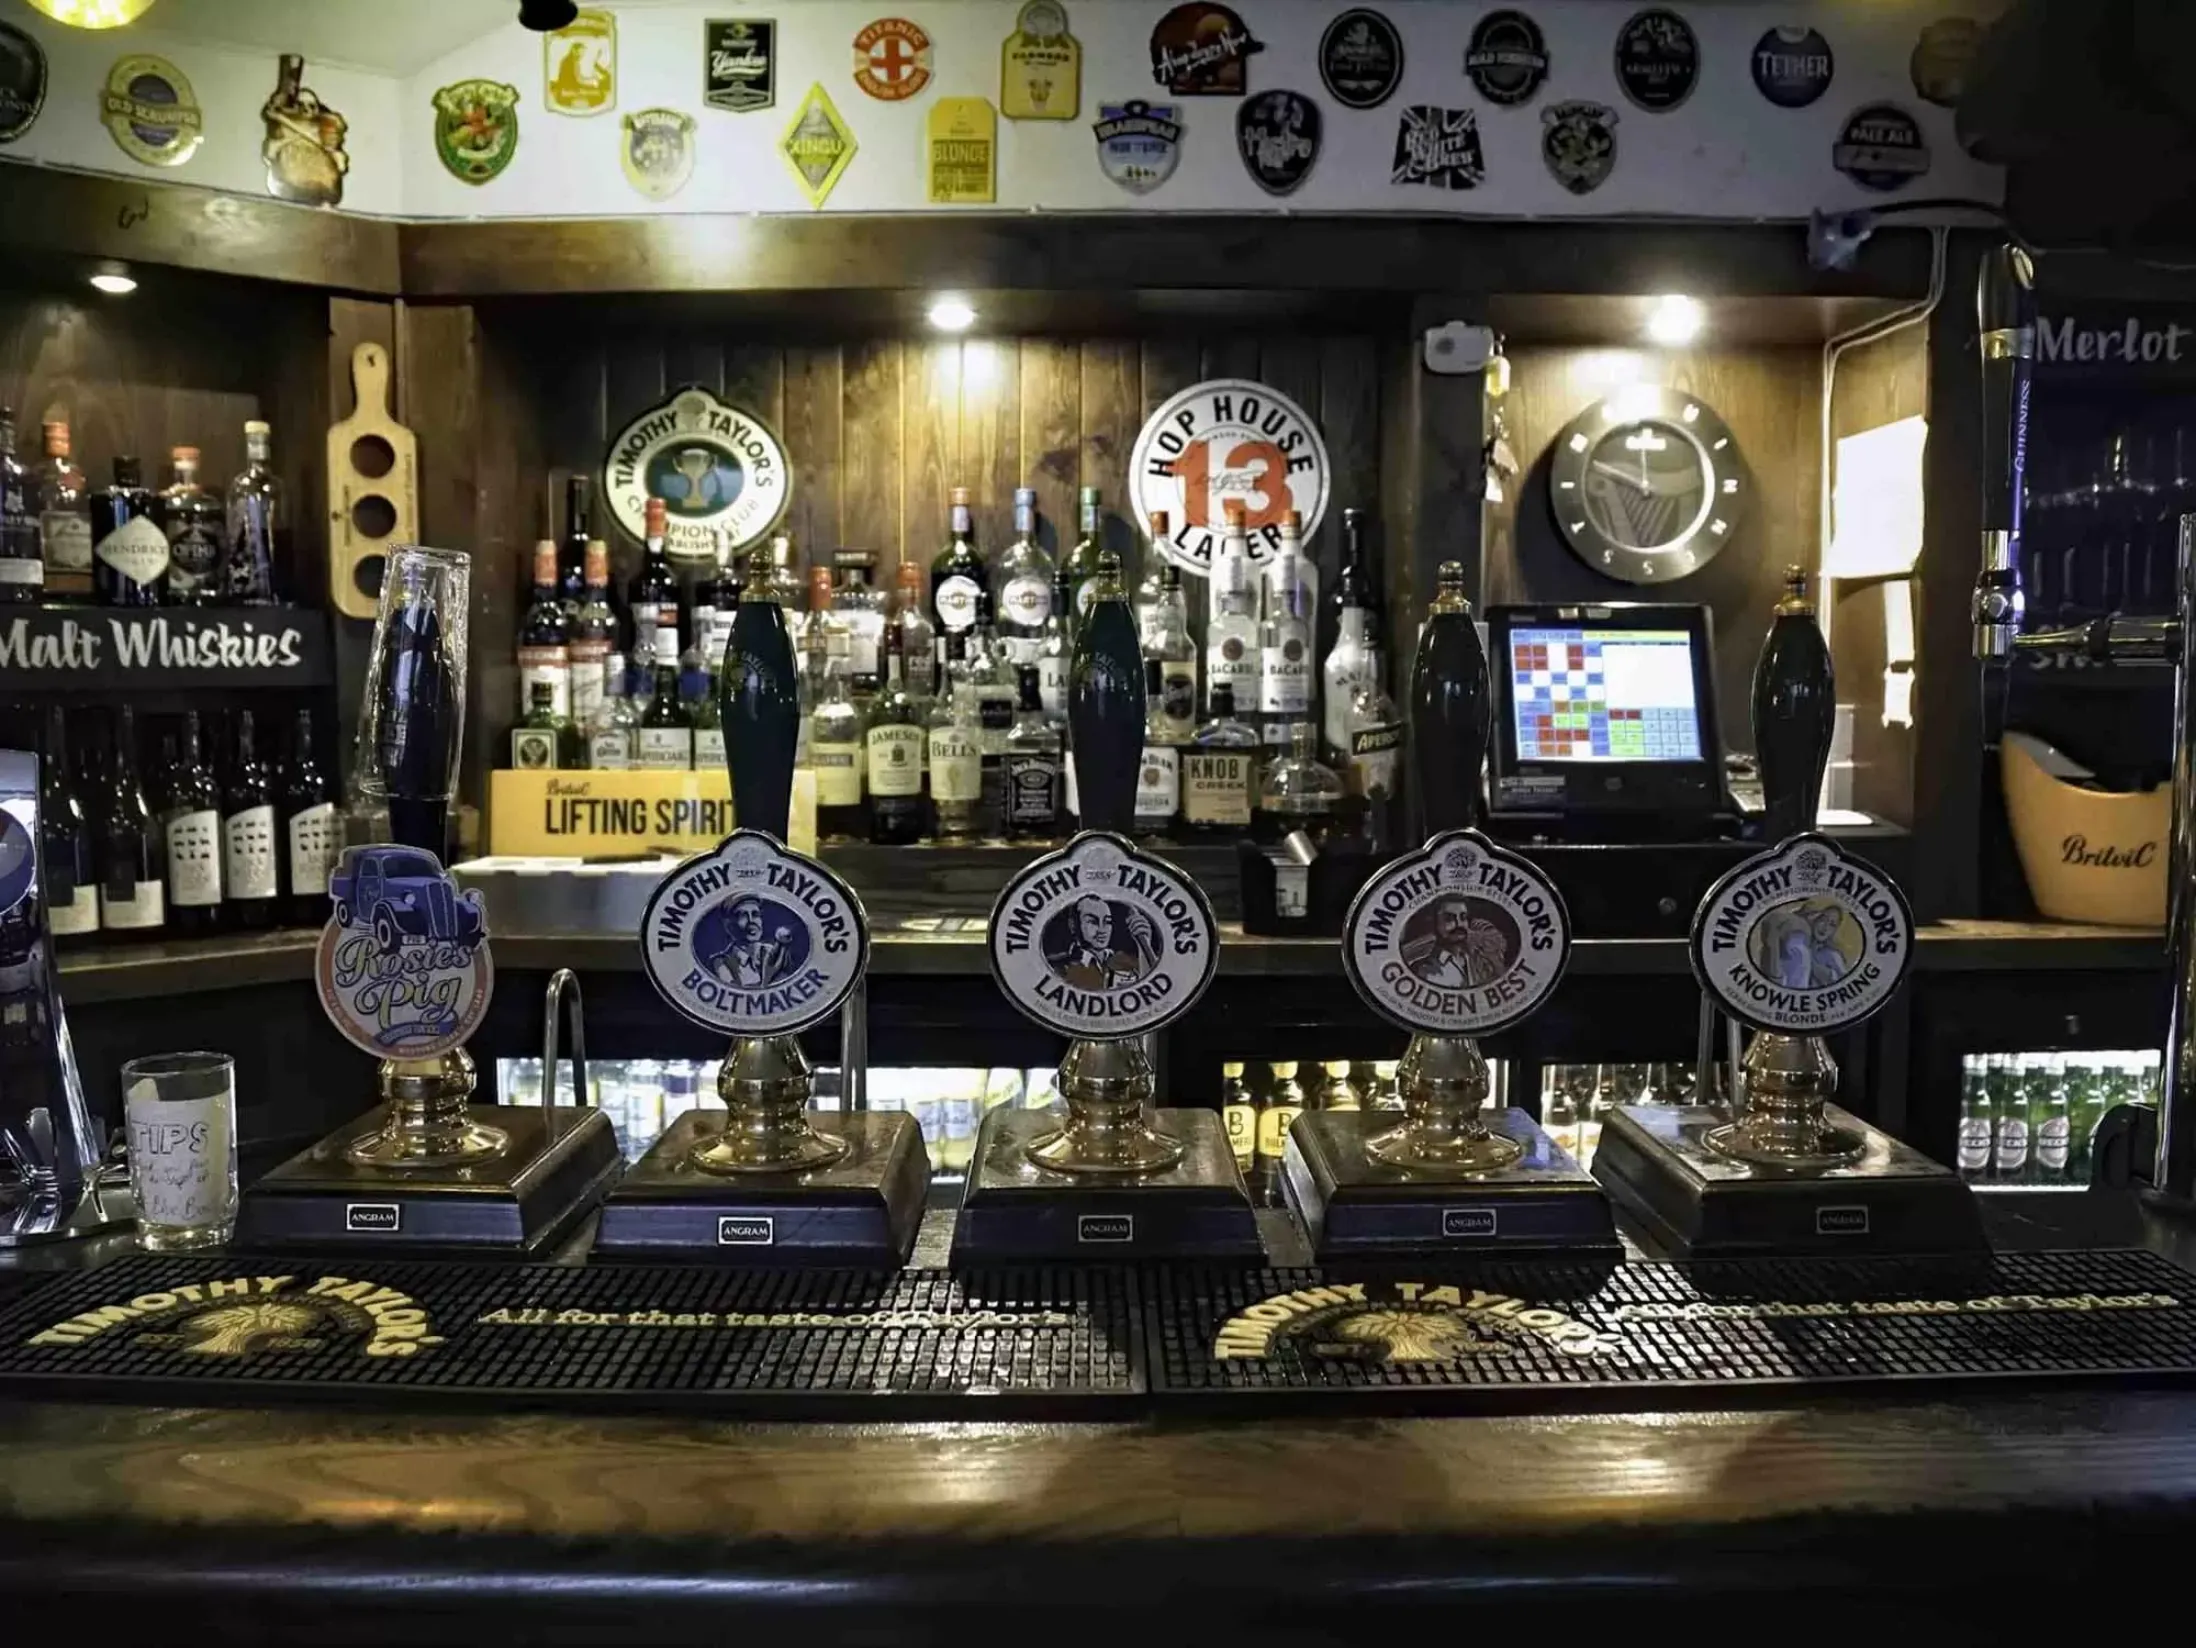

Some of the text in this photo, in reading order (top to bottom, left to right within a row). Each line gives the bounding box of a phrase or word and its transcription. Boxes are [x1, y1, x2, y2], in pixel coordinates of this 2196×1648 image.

[1758, 52, 1829, 80] TETHER
[2035, 316, 2193, 361] Merlot
[615, 411, 773, 489] TIMOTHY TAYLOR'S
[1148, 394, 1314, 477] HOP HOUSE
[2013, 380, 2030, 472] GUINNESS
[1173, 440, 1293, 527] 13
[0, 616, 302, 669] Malt Whiskies
[1191, 758, 1240, 778] KNOB
[545, 799, 646, 835] LIFTING
[658, 863, 848, 954] TIMOTHY TAYLOR'S
[1007, 865, 1201, 955] TIMOTHY TAYLOR'S
[1365, 863, 1557, 955] TIMOTHY TAYLOR'S
[1712, 866, 1901, 954] TIMOTHY TAYLOR'S
[354, 972, 461, 1030] Pig
[682, 968, 829, 1015] BOLTMAKER
[1034, 973, 1173, 1017] LANDLORD
[1381, 958, 1536, 1014] GOLDEN BEST
[1729, 963, 1811, 1013] KNOWLE
[1817, 962, 1881, 1012] SPRING
[1775, 1012, 1828, 1024] BLONDE
[132, 1121, 209, 1155] TIPS
[351, 1213, 395, 1223] ANGRAM
[723, 1225, 768, 1236] ANGRAM
[27, 1275, 447, 1357] TIMOTHY TAYLOR'S
[476, 1308, 549, 1325] All
[554, 1309, 620, 1326] for
[627, 1309, 717, 1326] that
[725, 1312, 834, 1327] taste
[1214, 1282, 1368, 1359] TIMOTHY
